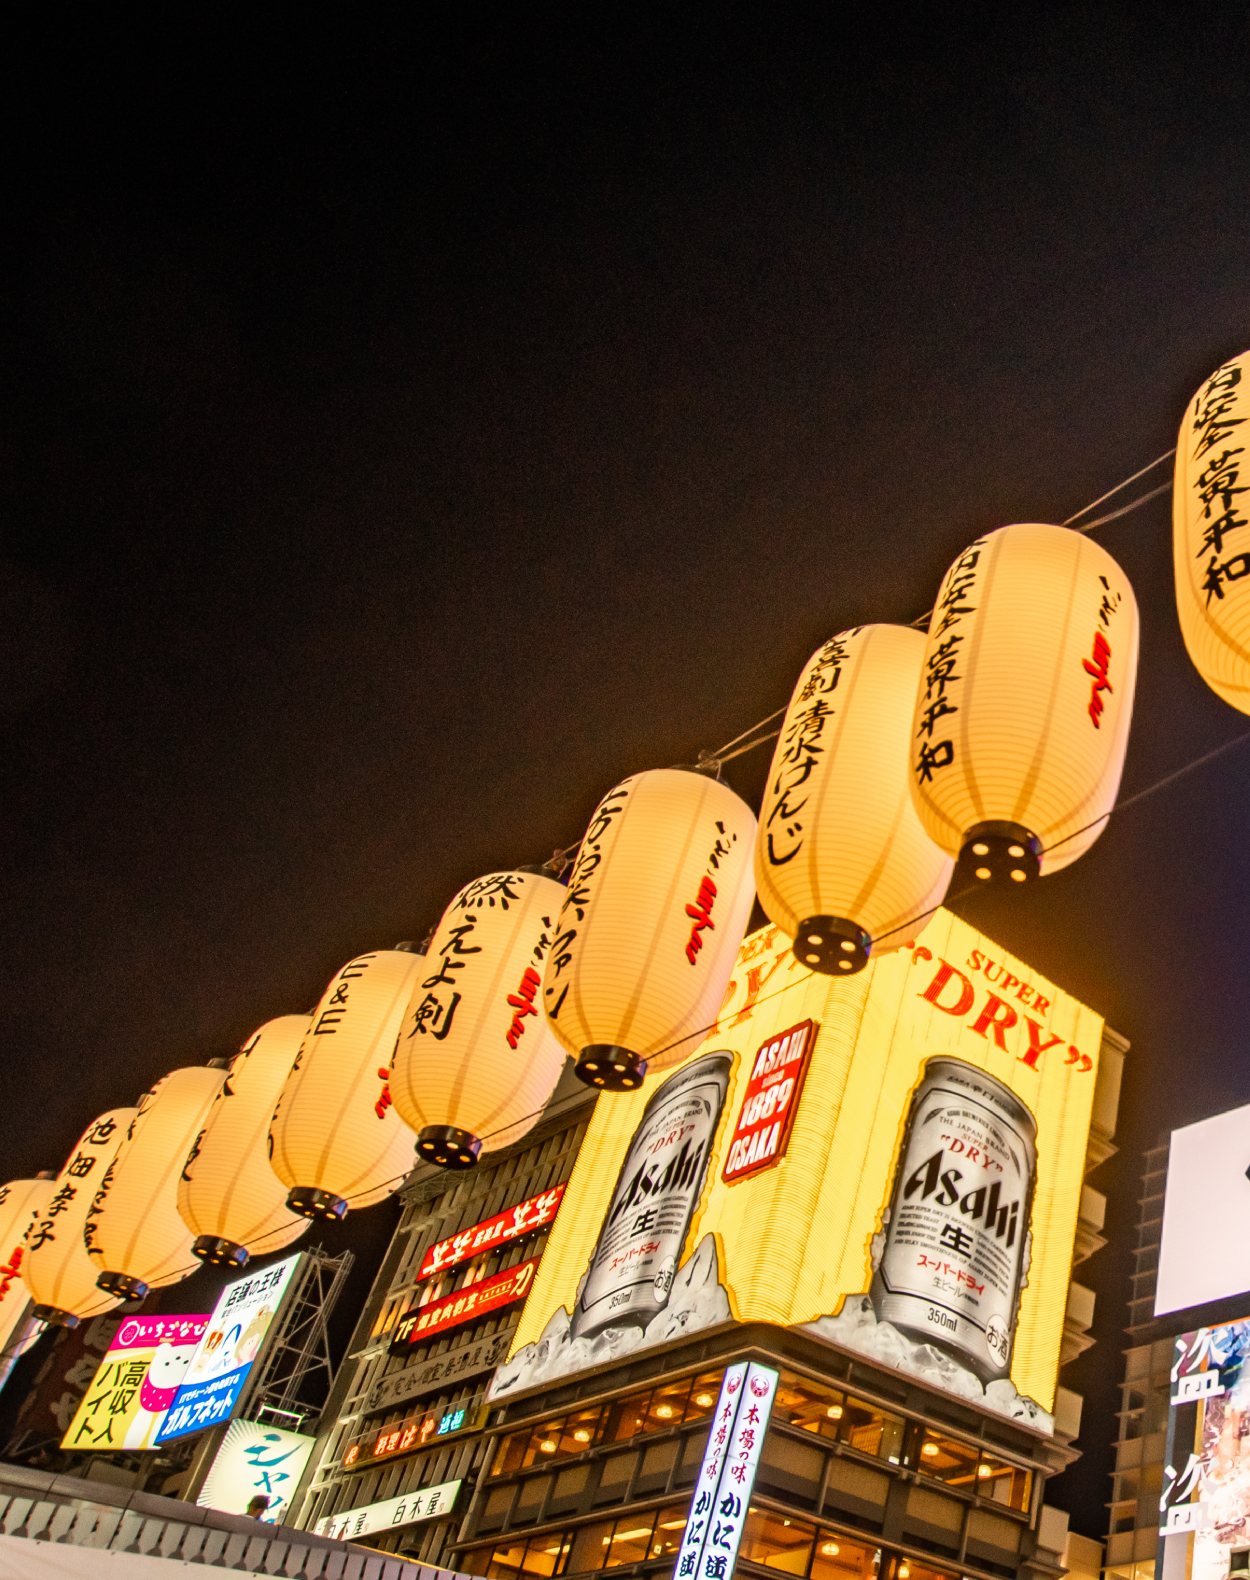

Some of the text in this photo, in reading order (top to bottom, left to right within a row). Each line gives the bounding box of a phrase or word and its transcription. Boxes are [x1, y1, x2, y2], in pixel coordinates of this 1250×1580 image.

[766, 627, 862, 866] 喜劇清水けんじ
[407, 874, 524, 1041] 燃えよ剣
[966, 948, 1051, 1018] SUPER
[750, 1025, 810, 1082] ASAHI
[761, 1068, 785, 1090] since
[738, 1077, 795, 1131] 1889
[724, 1120, 782, 1175] OSAKA
[939, 1115, 1010, 1161] THE JAPAN BRAND
[960, 1132, 989, 1152] SUPER
[608, 1137, 706, 1229] Asahi
[904, 1149, 1019, 1249] Asahi
[630, 1208, 658, 1238] 生
[939, 1223, 973, 1260] 生
[916, 1254, 986, 1296] スーパードライ
[394, 1316, 418, 1343] 7F
[927, 1306, 958, 1333] 350ml
[73, 1360, 129, 1444] バイト
[92, 1360, 151, 1444] 高収入
[160, 1388, 234, 1437] ガルフネット
[706, 1401, 732, 1481] 本場の味
[731, 1403, 760, 1485] 本場の味
[391, 1491, 443, 1525] 白木屋
